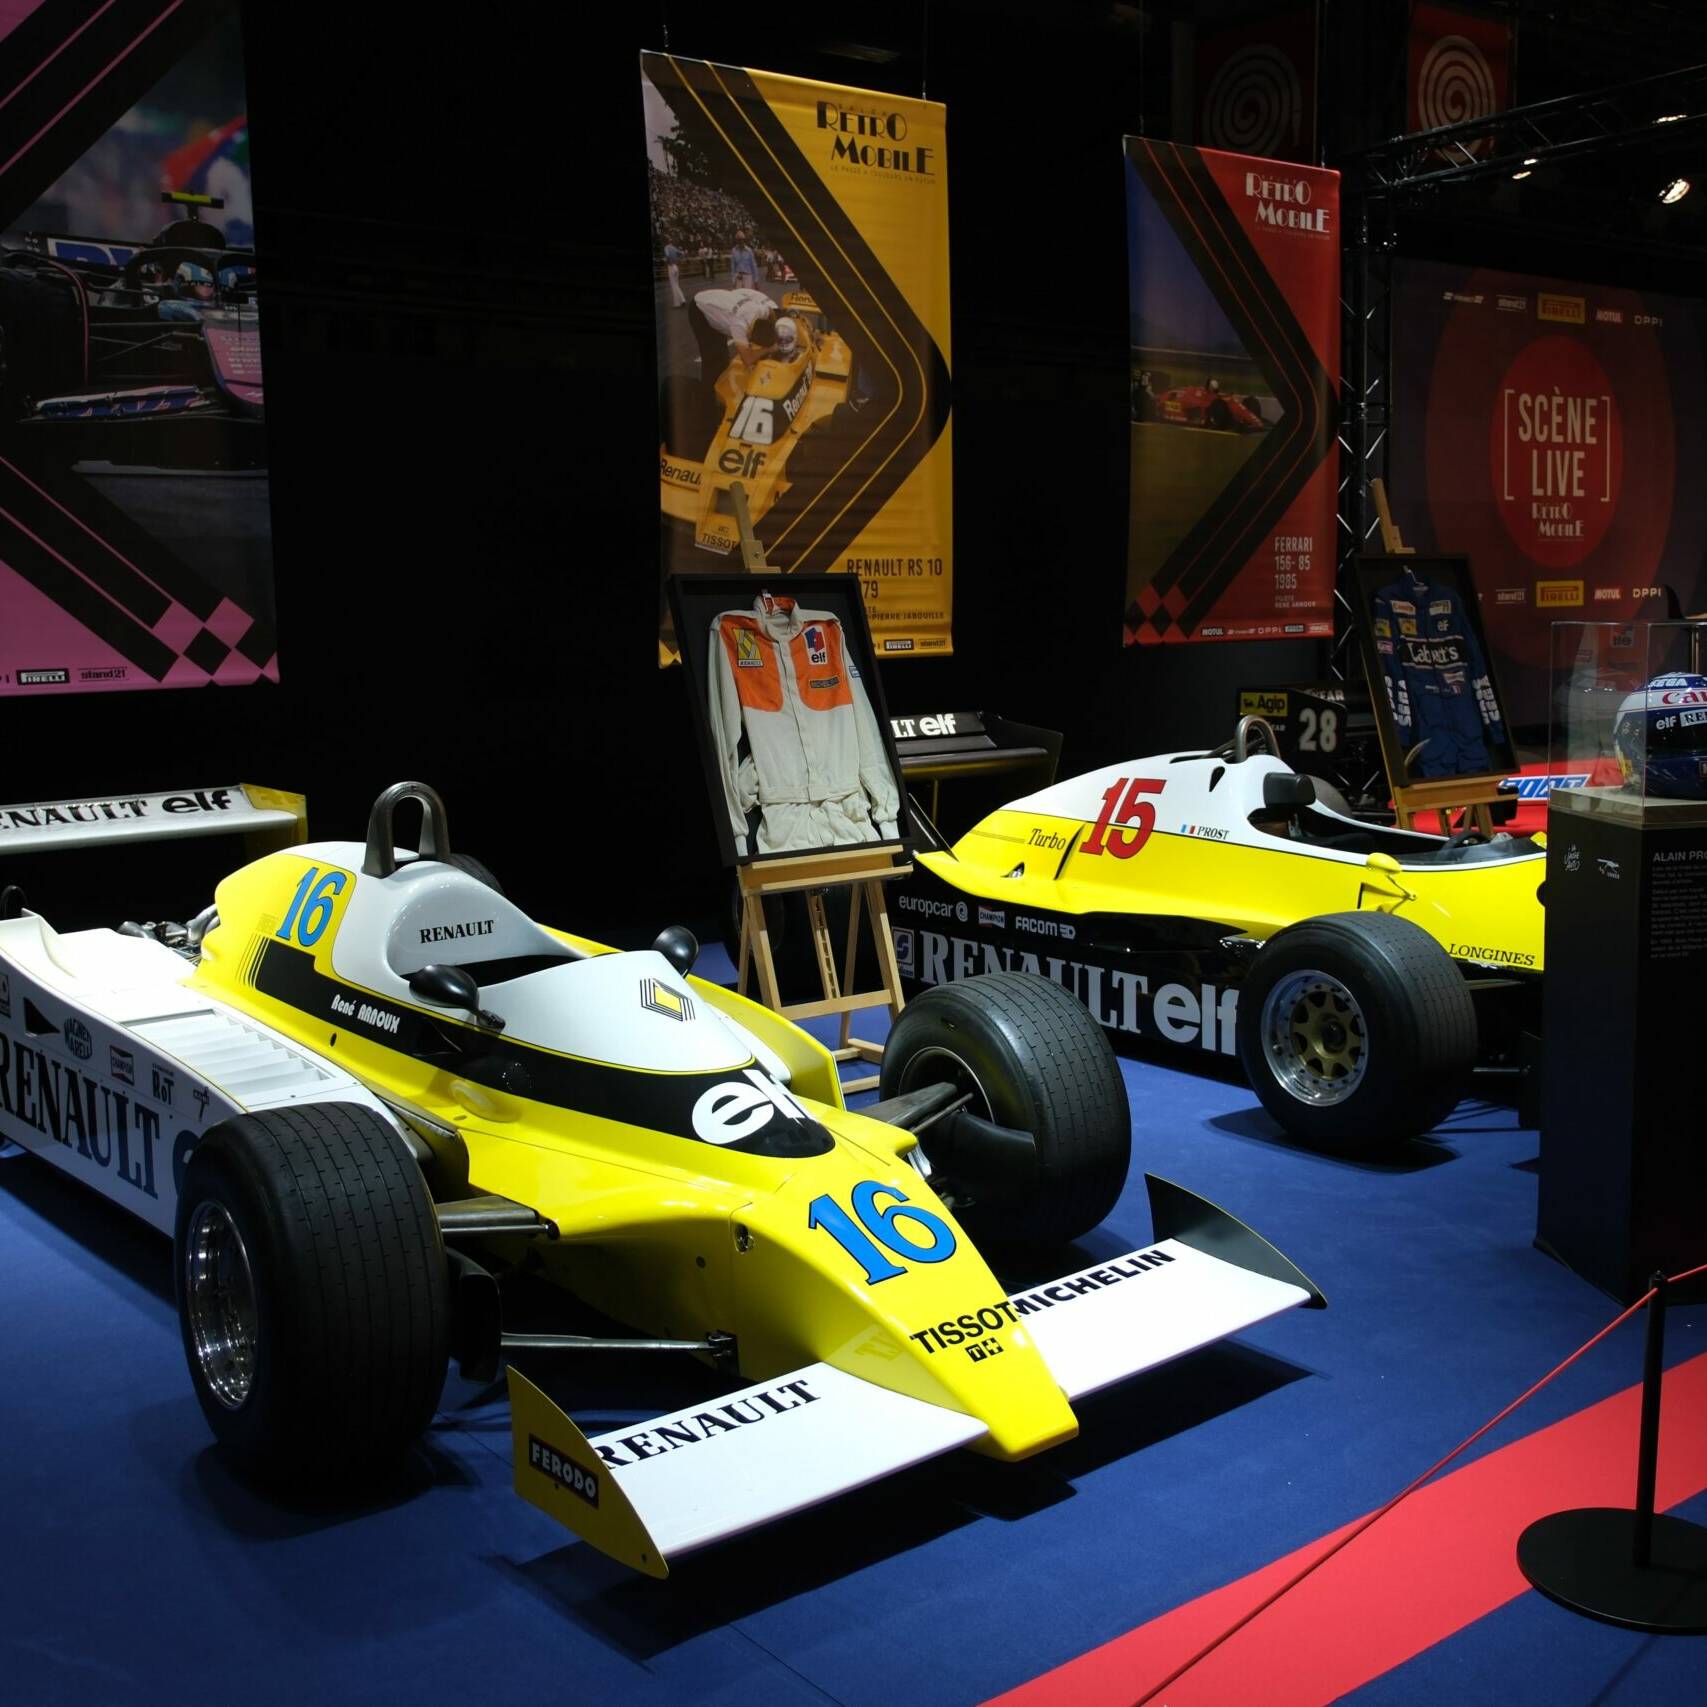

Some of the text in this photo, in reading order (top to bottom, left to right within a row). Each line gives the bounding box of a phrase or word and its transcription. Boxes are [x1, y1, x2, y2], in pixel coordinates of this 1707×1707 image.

[831, 134, 936, 175] MOBILE
[1255, 199, 1330, 233] MOBILE
[729, 395, 775, 445] 16
[1518, 385, 1597, 445] SCÈNE
[718, 448, 767, 479] elf
[1532, 449, 1585, 497] LIVE
[702, 533, 739, 551] TISSOT
[1274, 536, 1313, 552] FERRARI
[847, 558, 943, 577] RENAULT RS 10
[1298, 554, 1311, 571] 85
[1274, 573, 1297, 589] 1985
[1632, 587, 1662, 598] DPPI
[1593, 588, 1622, 600] MOTUL
[811, 652, 826, 664] elf
[81, 669, 126, 679] stand21
[1257, 694, 1286, 713] Agip
[918, 712, 957, 736] elf
[1298, 706, 1338, 753] 28
[1655, 715, 1678, 730] elf
[0, 790, 232, 829] NAULT elf
[1079, 777, 1167, 860] 15
[1027, 828, 1067, 850] Turbo
[1197, 826, 1229, 840] PROST
[1652, 851, 1686, 863] ALAIN
[276, 866, 348, 947] 16
[898, 895, 954, 919] europcar
[979, 910, 1004, 924] CHAMPION
[420, 920, 494, 944] RENAULT
[1015, 915, 1058, 937] FACOM
[1449, 943, 1535, 966] LONGINES
[331, 993, 357, 1017] René
[1153, 982, 1240, 1057] elf
[808, 1180, 957, 1286] 16
[1012, 1248, 1177, 1318] MICHELIN
[909, 1301, 1019, 1354] TISSOT
[594, 1379, 821, 1470] RENAULT
[531, 1441, 597, 1501] FERODO
